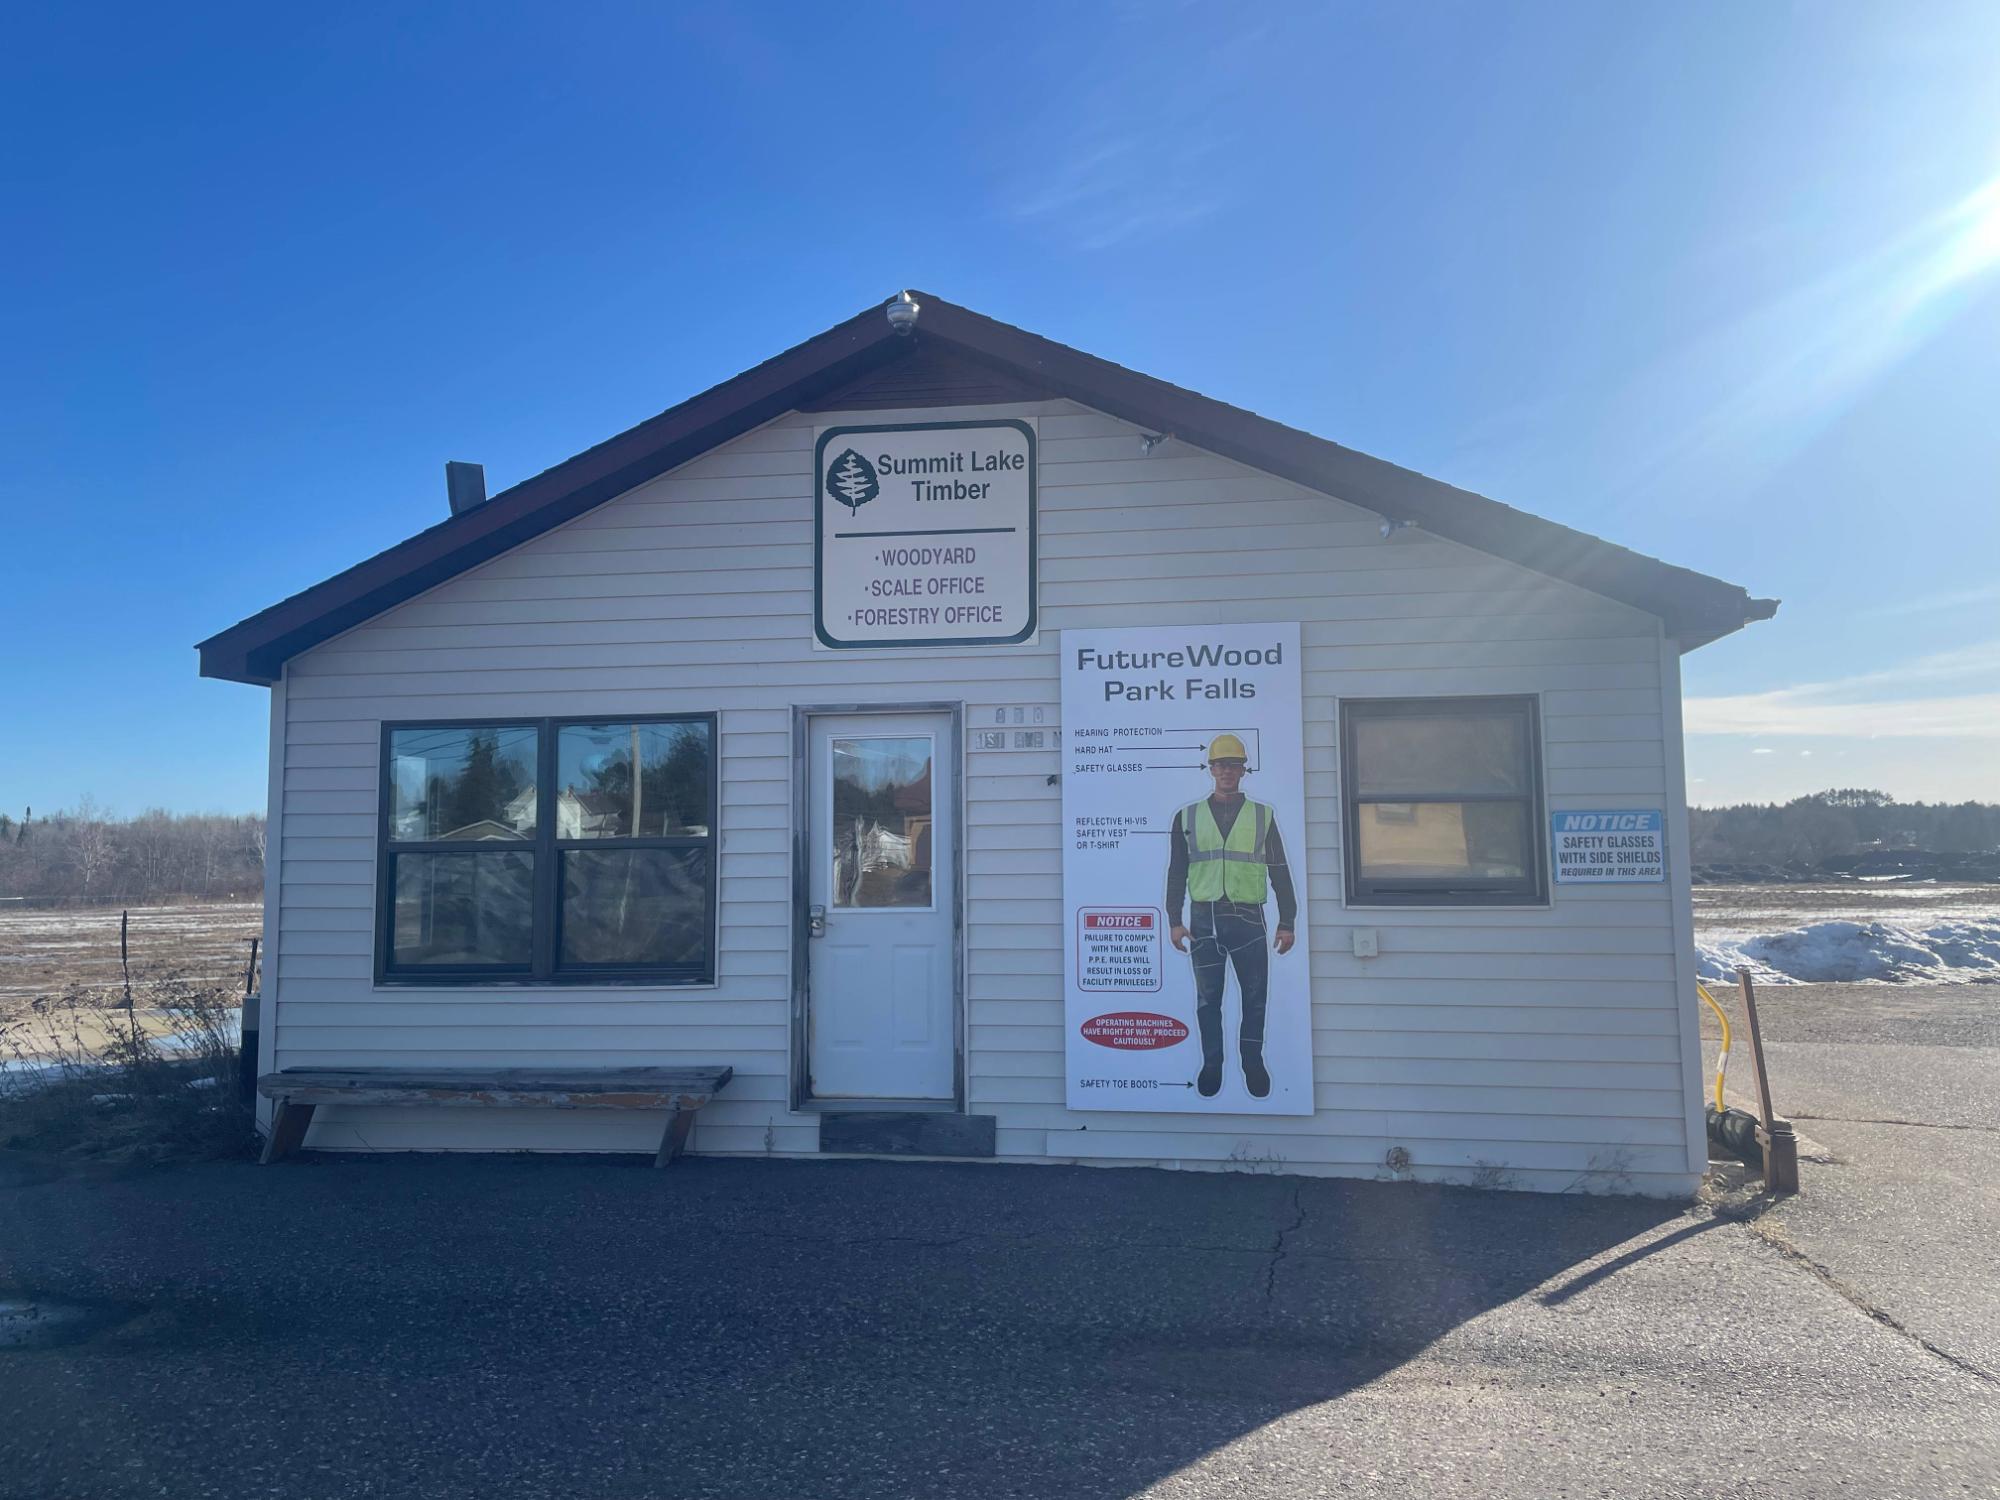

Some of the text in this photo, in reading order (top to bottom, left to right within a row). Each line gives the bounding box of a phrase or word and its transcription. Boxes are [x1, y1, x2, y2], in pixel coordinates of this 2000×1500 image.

[878, 450, 1025, 475] Summit Lake
[911, 480, 990, 501] Timber
[882, 547, 976, 566] WOODYARD
[871, 577, 985, 597] SCALE OFFICE
[855, 605, 1002, 626] FORESTRY OFFICE
[1077, 642, 1283, 670] FutureWood
[1104, 678, 1256, 702] Park Falls
[1074, 727, 1163, 737] HEARING PROTECTION
[1074, 745, 1113, 754] HARD HAT
[1075, 763, 1143, 773] SAFETY GLASSES
[1076, 817, 1148, 826] REFLECTIVE HI-VIS
[1563, 814, 1652, 831] NOTICE
[1076, 829, 1128, 838] SAFETY VEST
[1076, 840, 1120, 849] OR T-SHIRT
[1563, 835, 1655, 849] SAFETY GLASSES
[1559, 851, 1661, 864] WITH SIDE SHIELDS
[1560, 867, 1661, 877] REQUIRED IN THIS AREA
[1096, 916, 1142, 927] NOTICE
[1085, 934, 1114, 942] FAILURE
[1124, 934, 1154, 942] COMPLY
[1091, 945, 1148, 953] WITH THE ABOVE
[1109, 956, 1132, 964] RULES
[1133, 956, 1150, 964] WILL
[1087, 967, 1152, 975] RESULT IN LOSS OF
[1082, 978, 1157, 986] FACILITY PRIVILEGES!
[1095, 1018, 1174, 1028] OPERATING MACHINES
[1083, 1028, 1101, 1036] HAVE
[1153, 1029, 1186, 1037] PROCEED
[1113, 1037, 1156, 1046] CAUTIOUSLY
[1080, 1079, 1159, 1089] SAFETY TOE BOOTS
